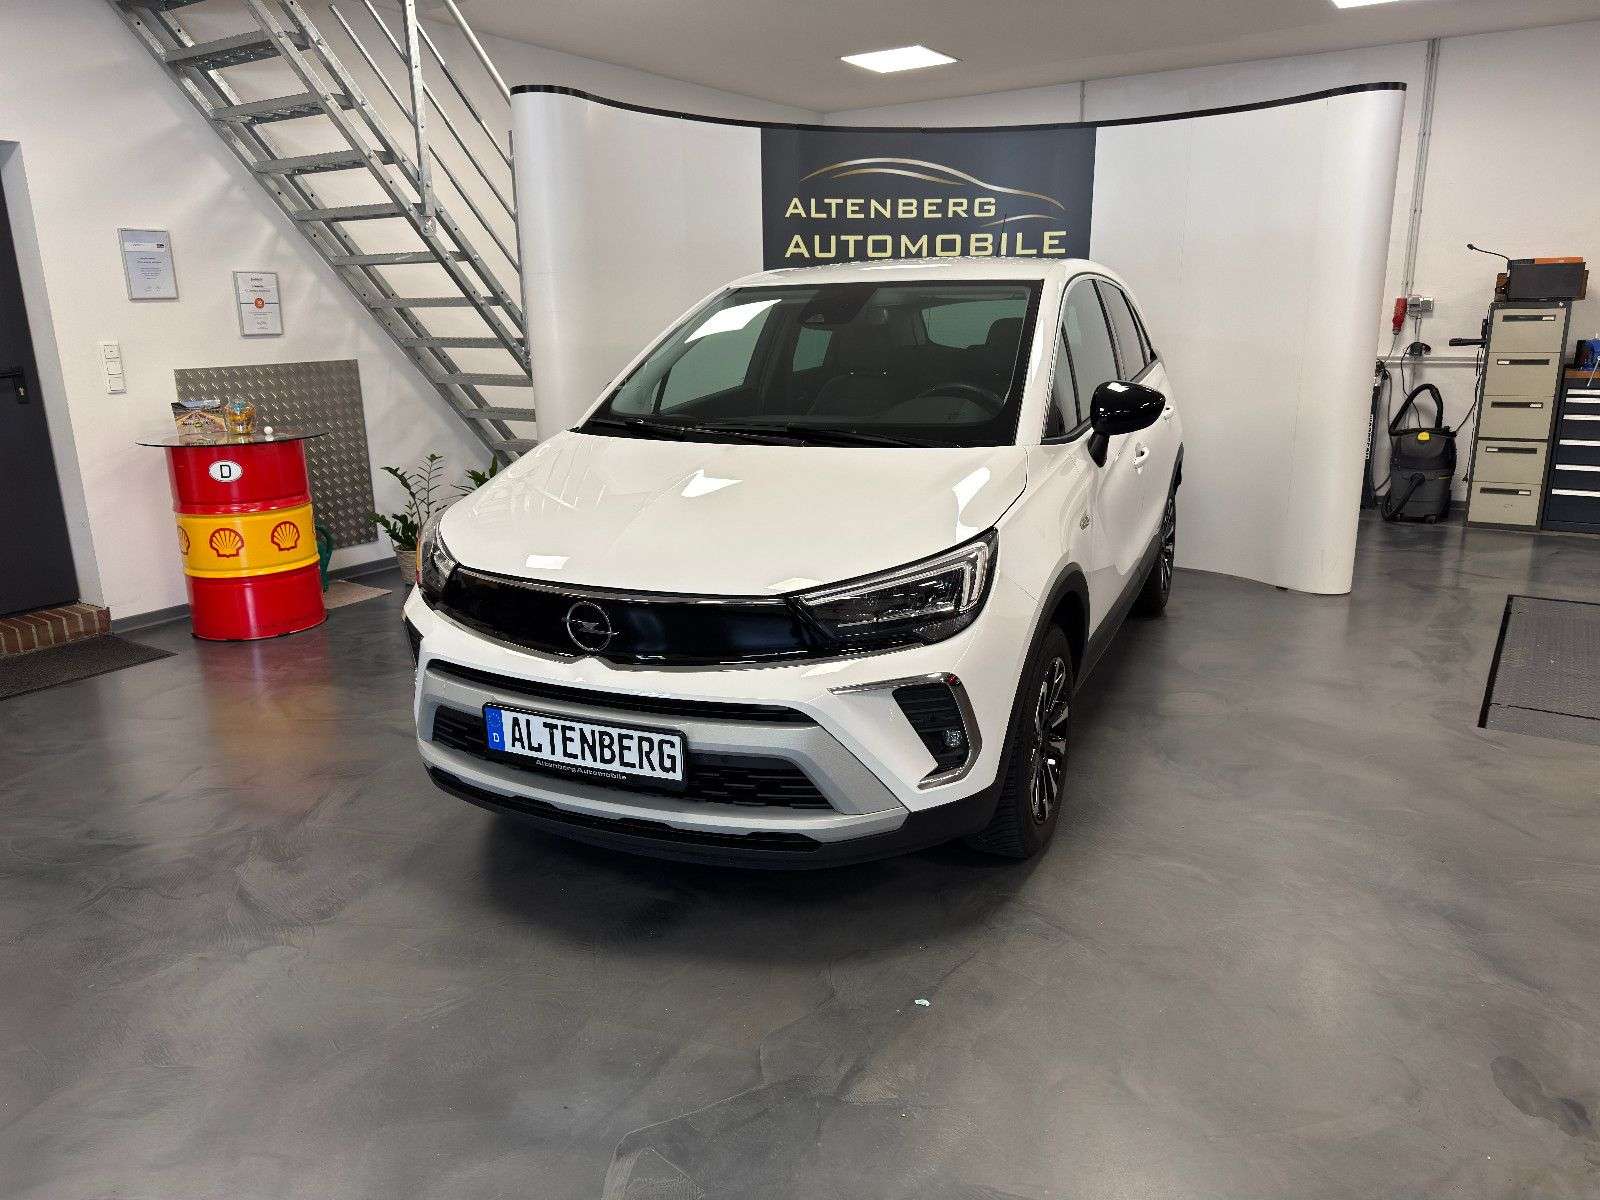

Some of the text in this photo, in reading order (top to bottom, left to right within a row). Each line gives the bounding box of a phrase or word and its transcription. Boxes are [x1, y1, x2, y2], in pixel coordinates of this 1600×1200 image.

[784, 197, 997, 219] ALTENBERG
[784, 230, 1067, 258] AUTOMOBILE
[219, 464, 232, 479] D
[492, 716, 677, 774] D ALTENBERG
[535, 759, 627, 780] Altenberg Automobile
